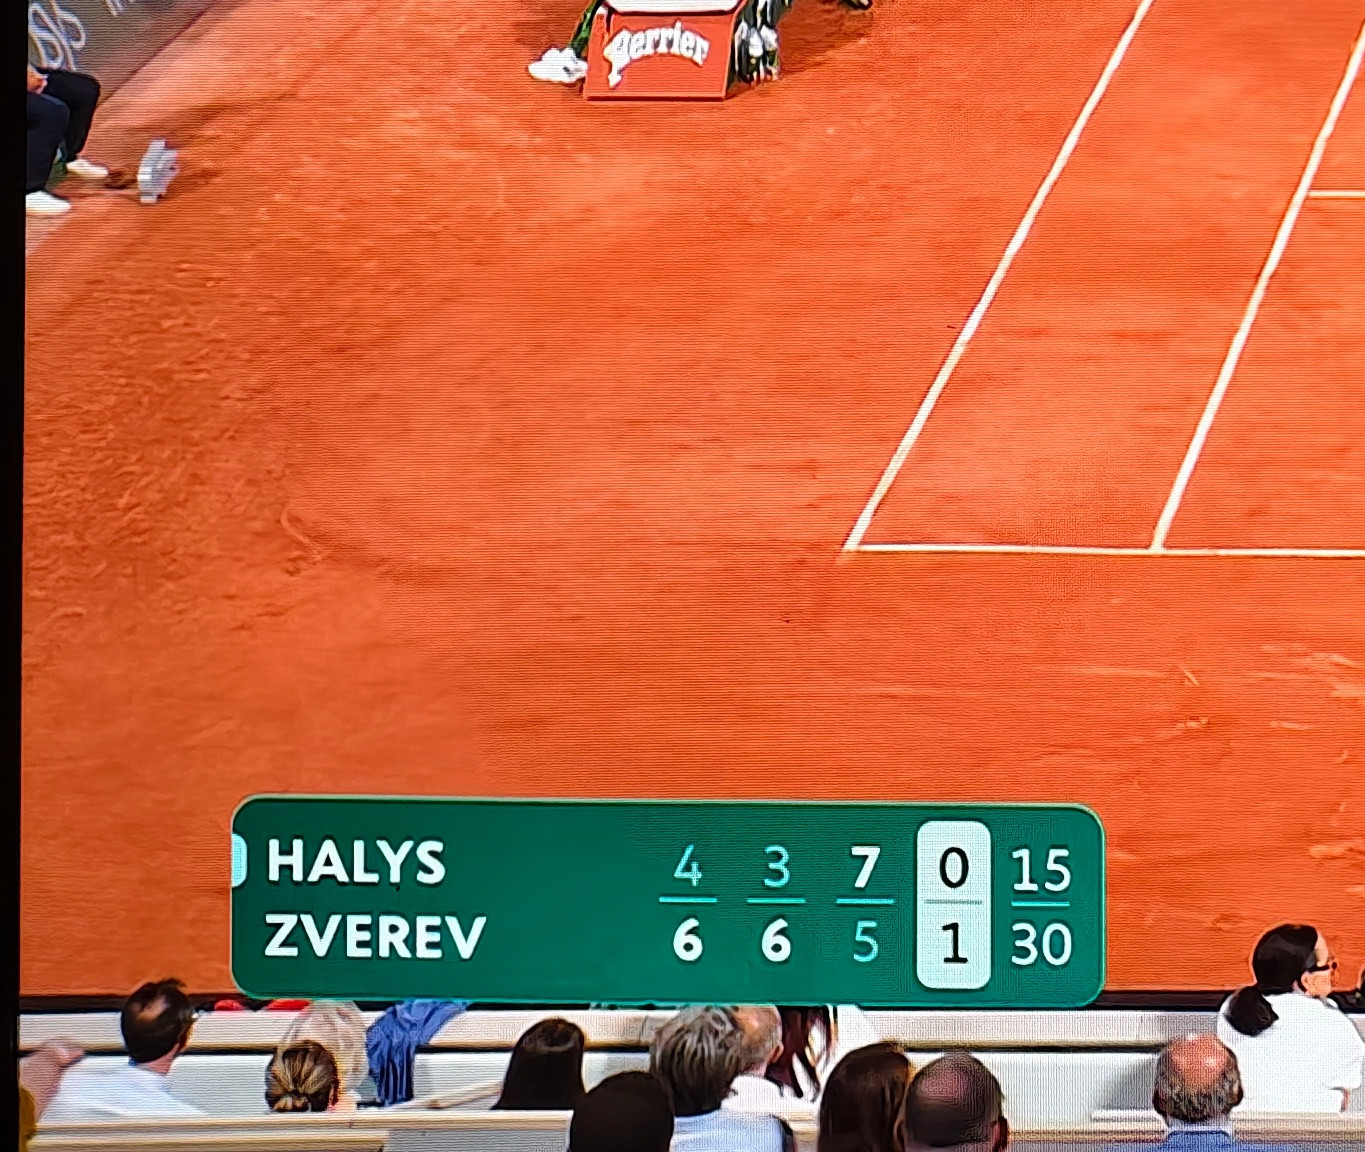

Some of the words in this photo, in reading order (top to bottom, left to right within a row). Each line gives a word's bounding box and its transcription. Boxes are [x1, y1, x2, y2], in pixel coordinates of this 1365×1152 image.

[267, 838, 446, 886] HALYS
[673, 844, 703, 886] 4
[763, 846, 791, 888] 3
[851, 846, 881, 888] 7
[938, 847, 970, 890] 0
[1011, 849, 1072, 892] 15
[264, 916, 487, 960] ZVEREV
[672, 918, 704, 962] 6
[761, 919, 792, 963] 6
[852, 921, 879, 964] 5
[942, 922, 968, 965] 1
[1010, 923, 1072, 967] 30
